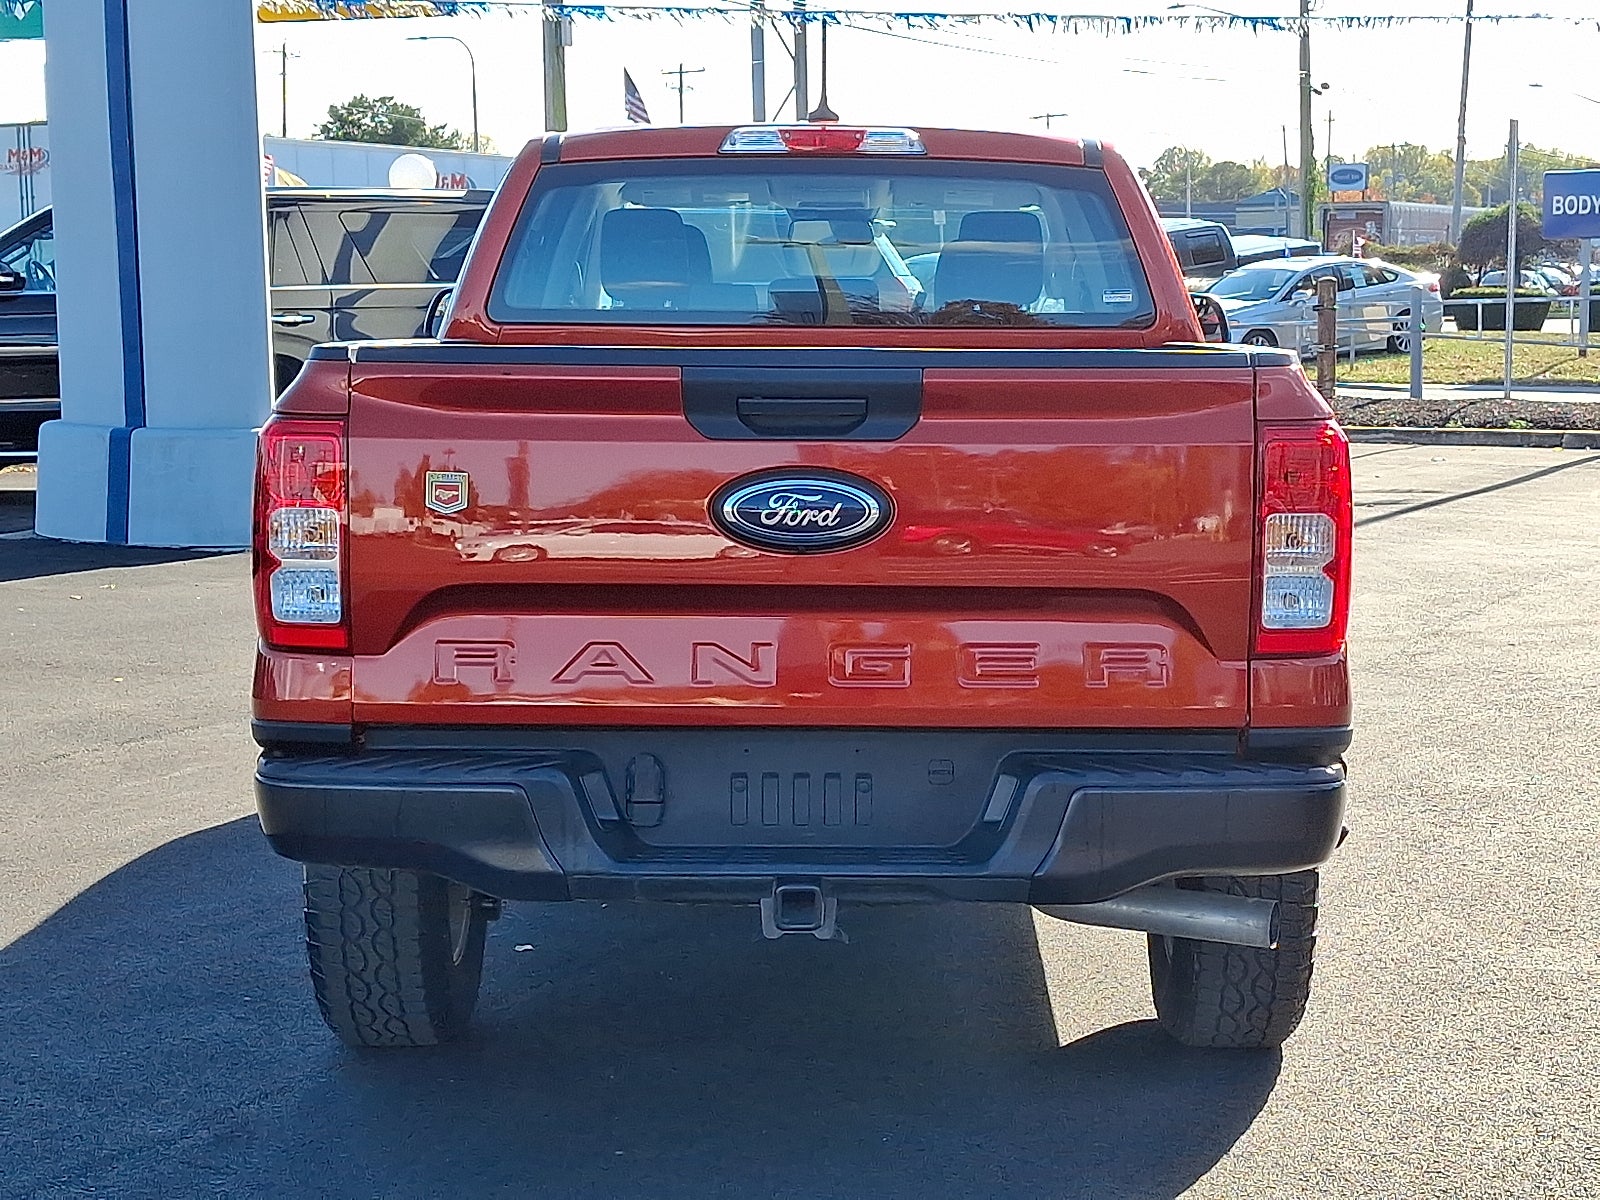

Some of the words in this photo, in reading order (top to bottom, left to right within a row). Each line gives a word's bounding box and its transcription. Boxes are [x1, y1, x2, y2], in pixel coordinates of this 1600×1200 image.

[1552, 194, 1600, 216] BODY
[760, 492, 843, 527] Ford
[433, 638, 1170, 689] RANGER
